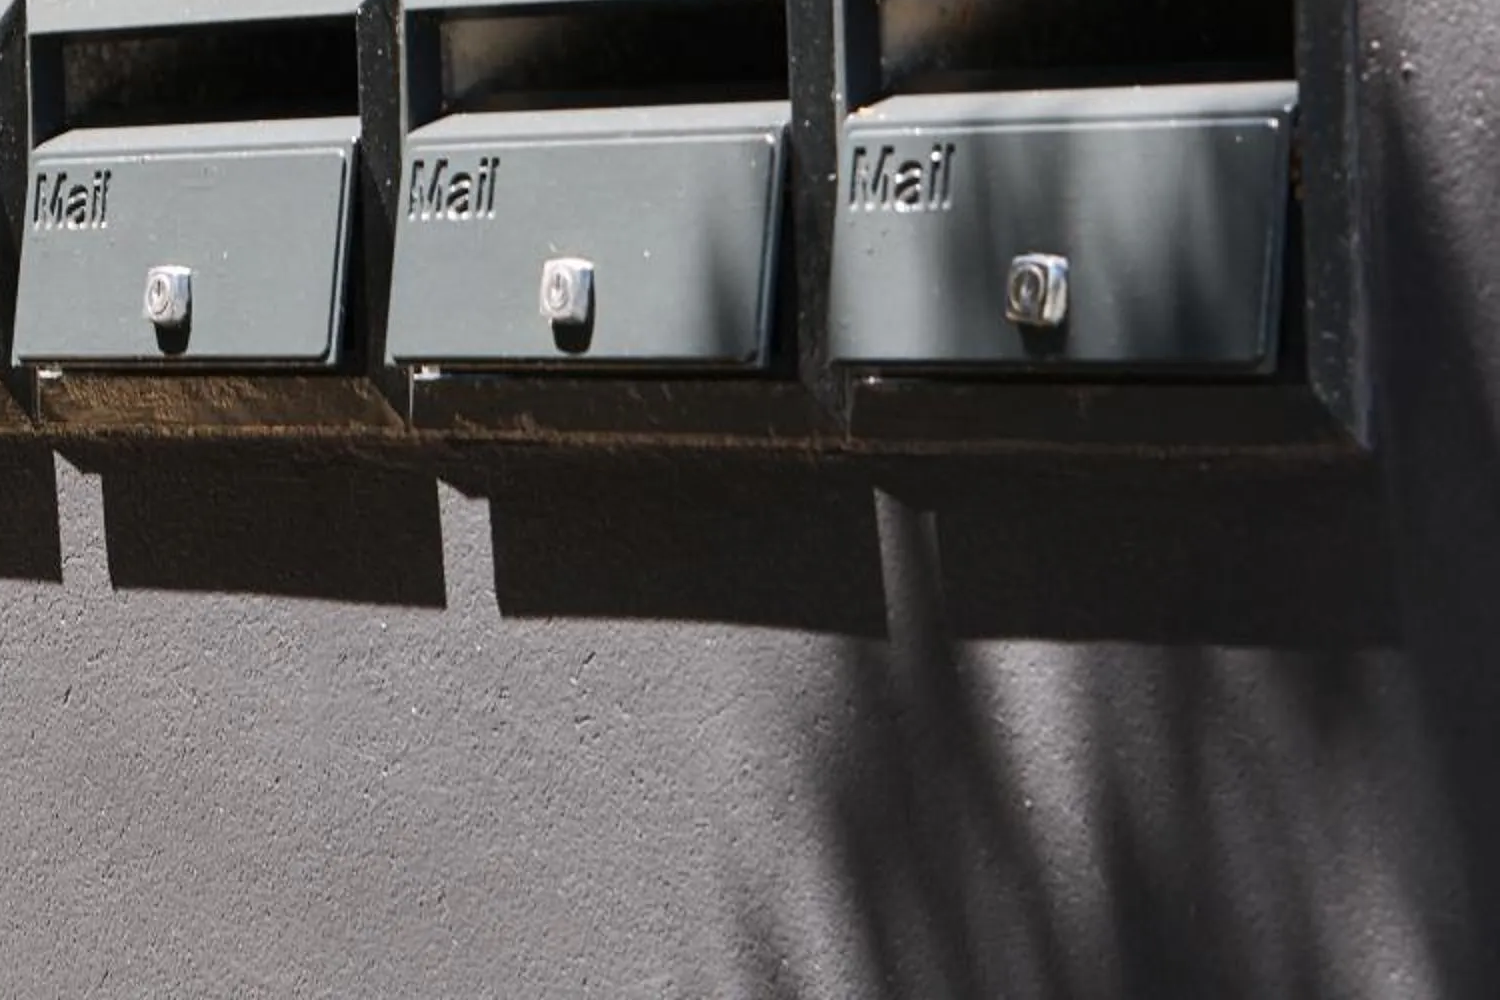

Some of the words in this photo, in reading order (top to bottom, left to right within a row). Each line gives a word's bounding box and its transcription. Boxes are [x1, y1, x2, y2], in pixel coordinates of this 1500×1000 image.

[32, 169, 112, 229] Mail
[407, 156, 500, 221] Mail
[850, 141, 957, 212] Mail
